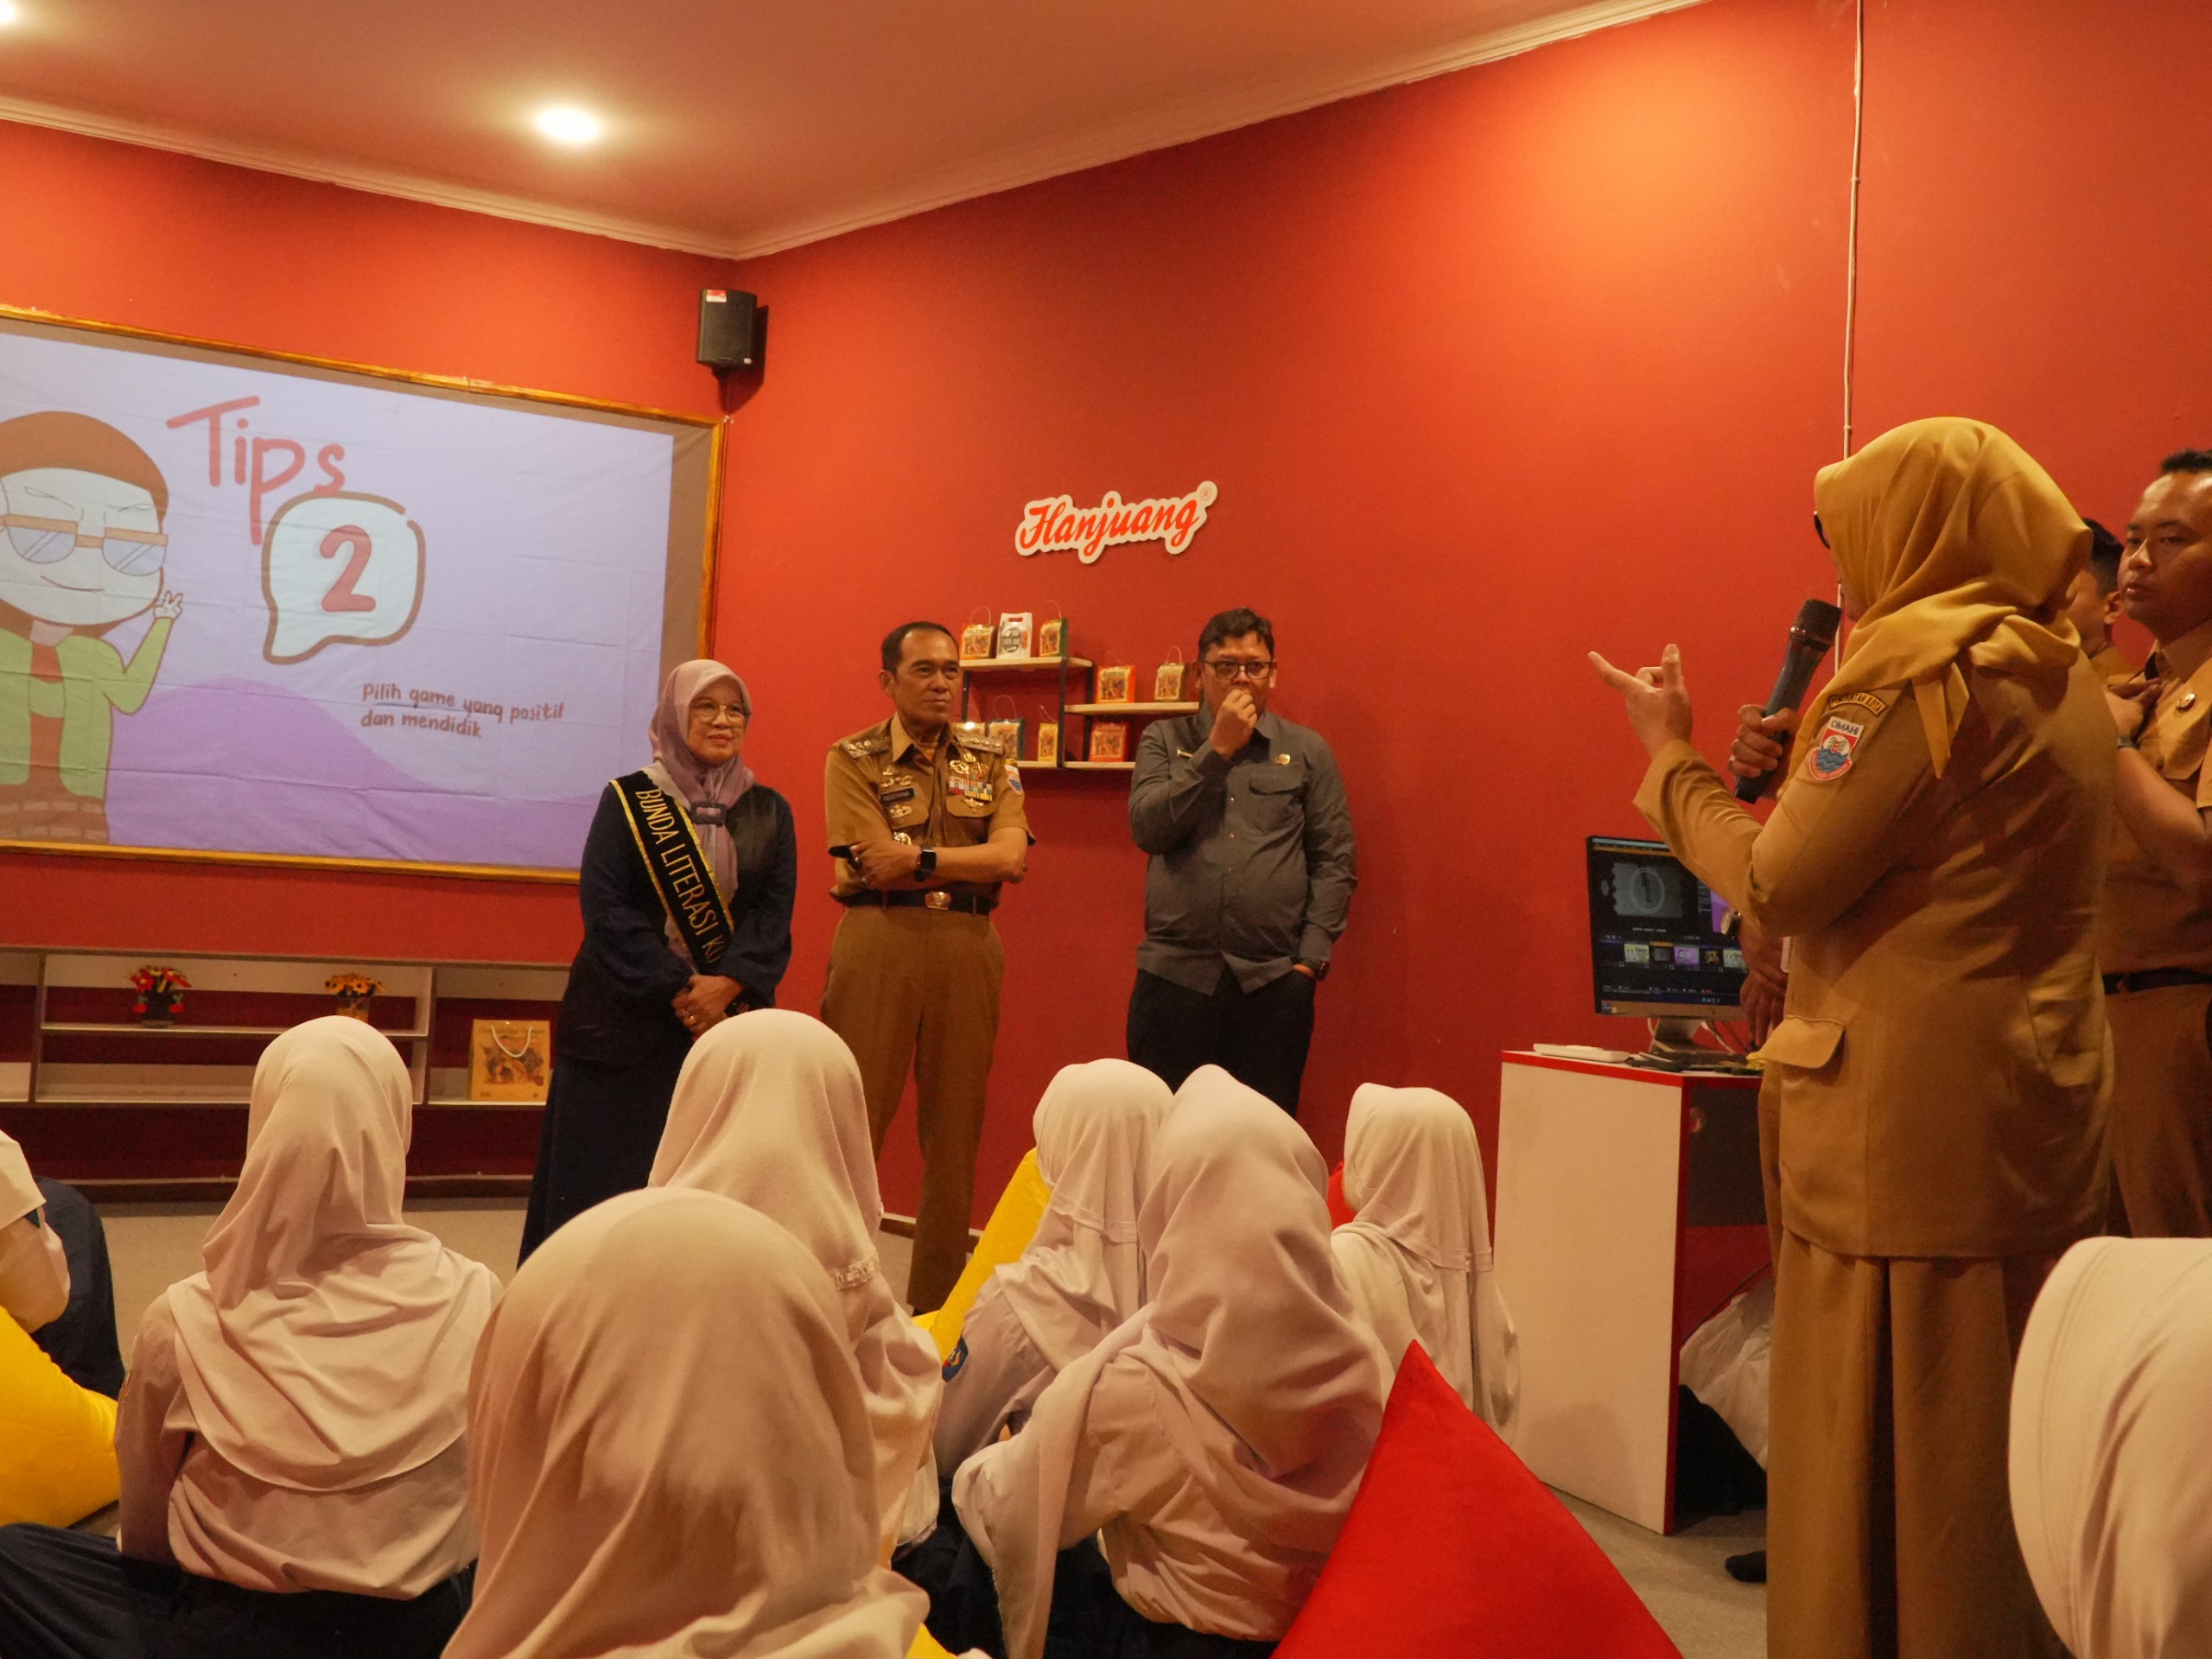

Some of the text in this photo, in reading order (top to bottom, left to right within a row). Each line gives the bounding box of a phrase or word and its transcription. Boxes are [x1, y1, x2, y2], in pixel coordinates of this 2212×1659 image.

[166, 395, 346, 546] Tips
[1020, 497, 1200, 557] Hanjuang
[319, 524, 377, 613] 2
[360, 709, 483, 738] dan mendidik
[362, 683, 565, 724] Pilih game yang positif
[1830, 720, 1860, 736] CIMAHI
[635, 788, 680, 845] BUNDA
[660, 842, 720, 937] LITERASI
